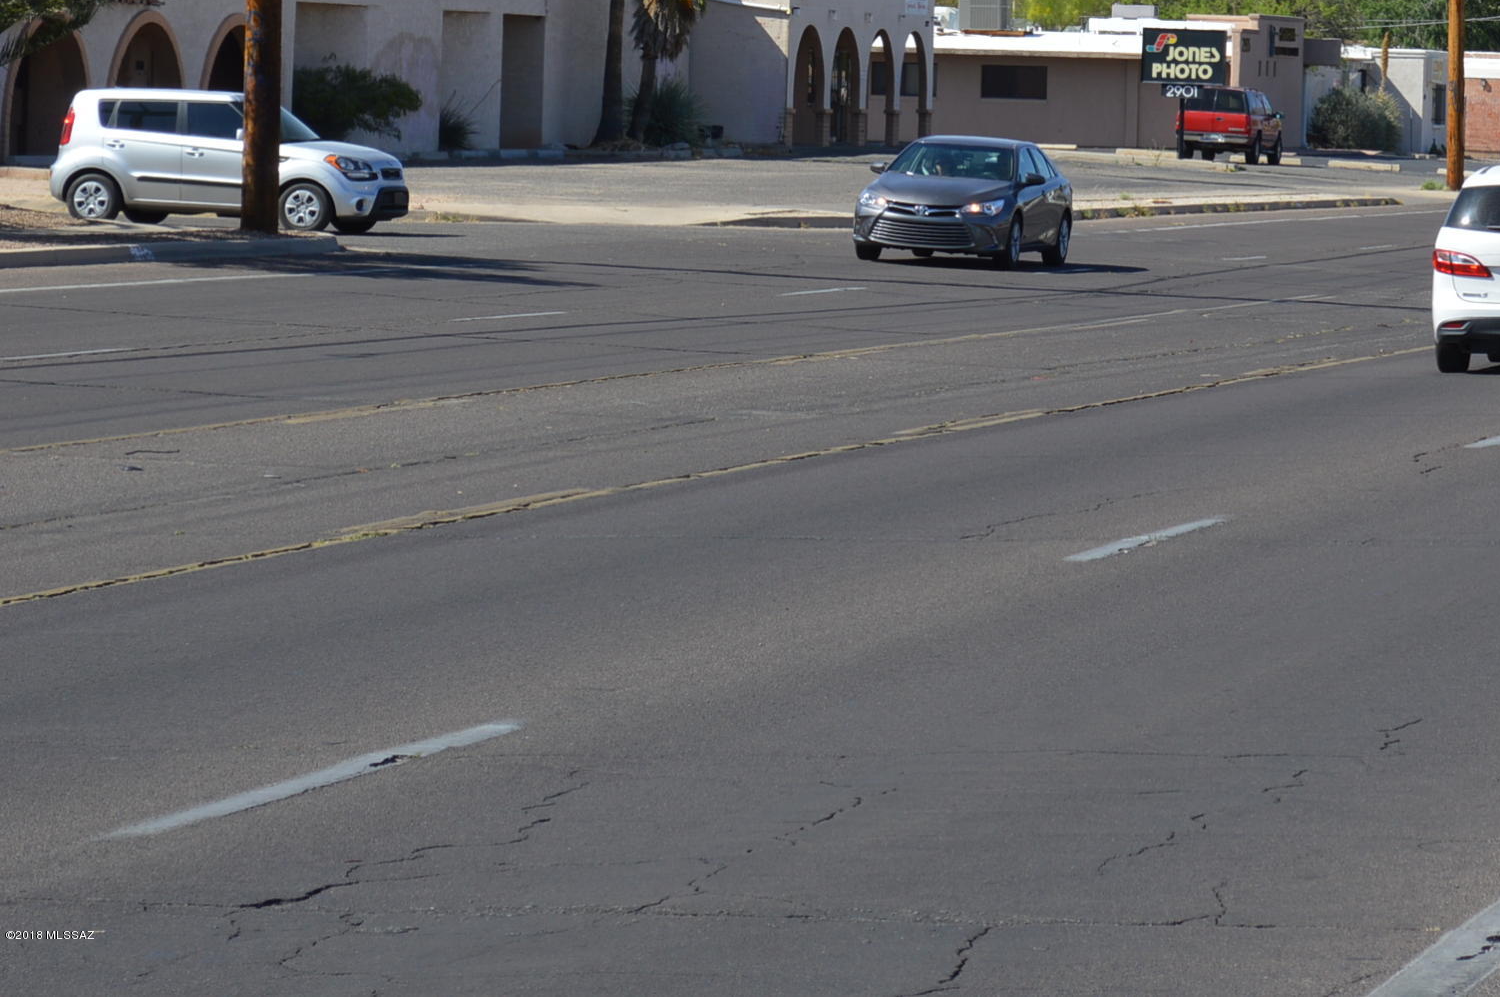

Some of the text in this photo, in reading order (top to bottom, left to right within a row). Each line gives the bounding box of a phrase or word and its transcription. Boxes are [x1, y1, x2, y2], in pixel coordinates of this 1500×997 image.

[1166, 46, 1221, 63] JONES
[1151, 63, 1213, 80] PHOTO
[1165, 85, 1198, 98] 2901
